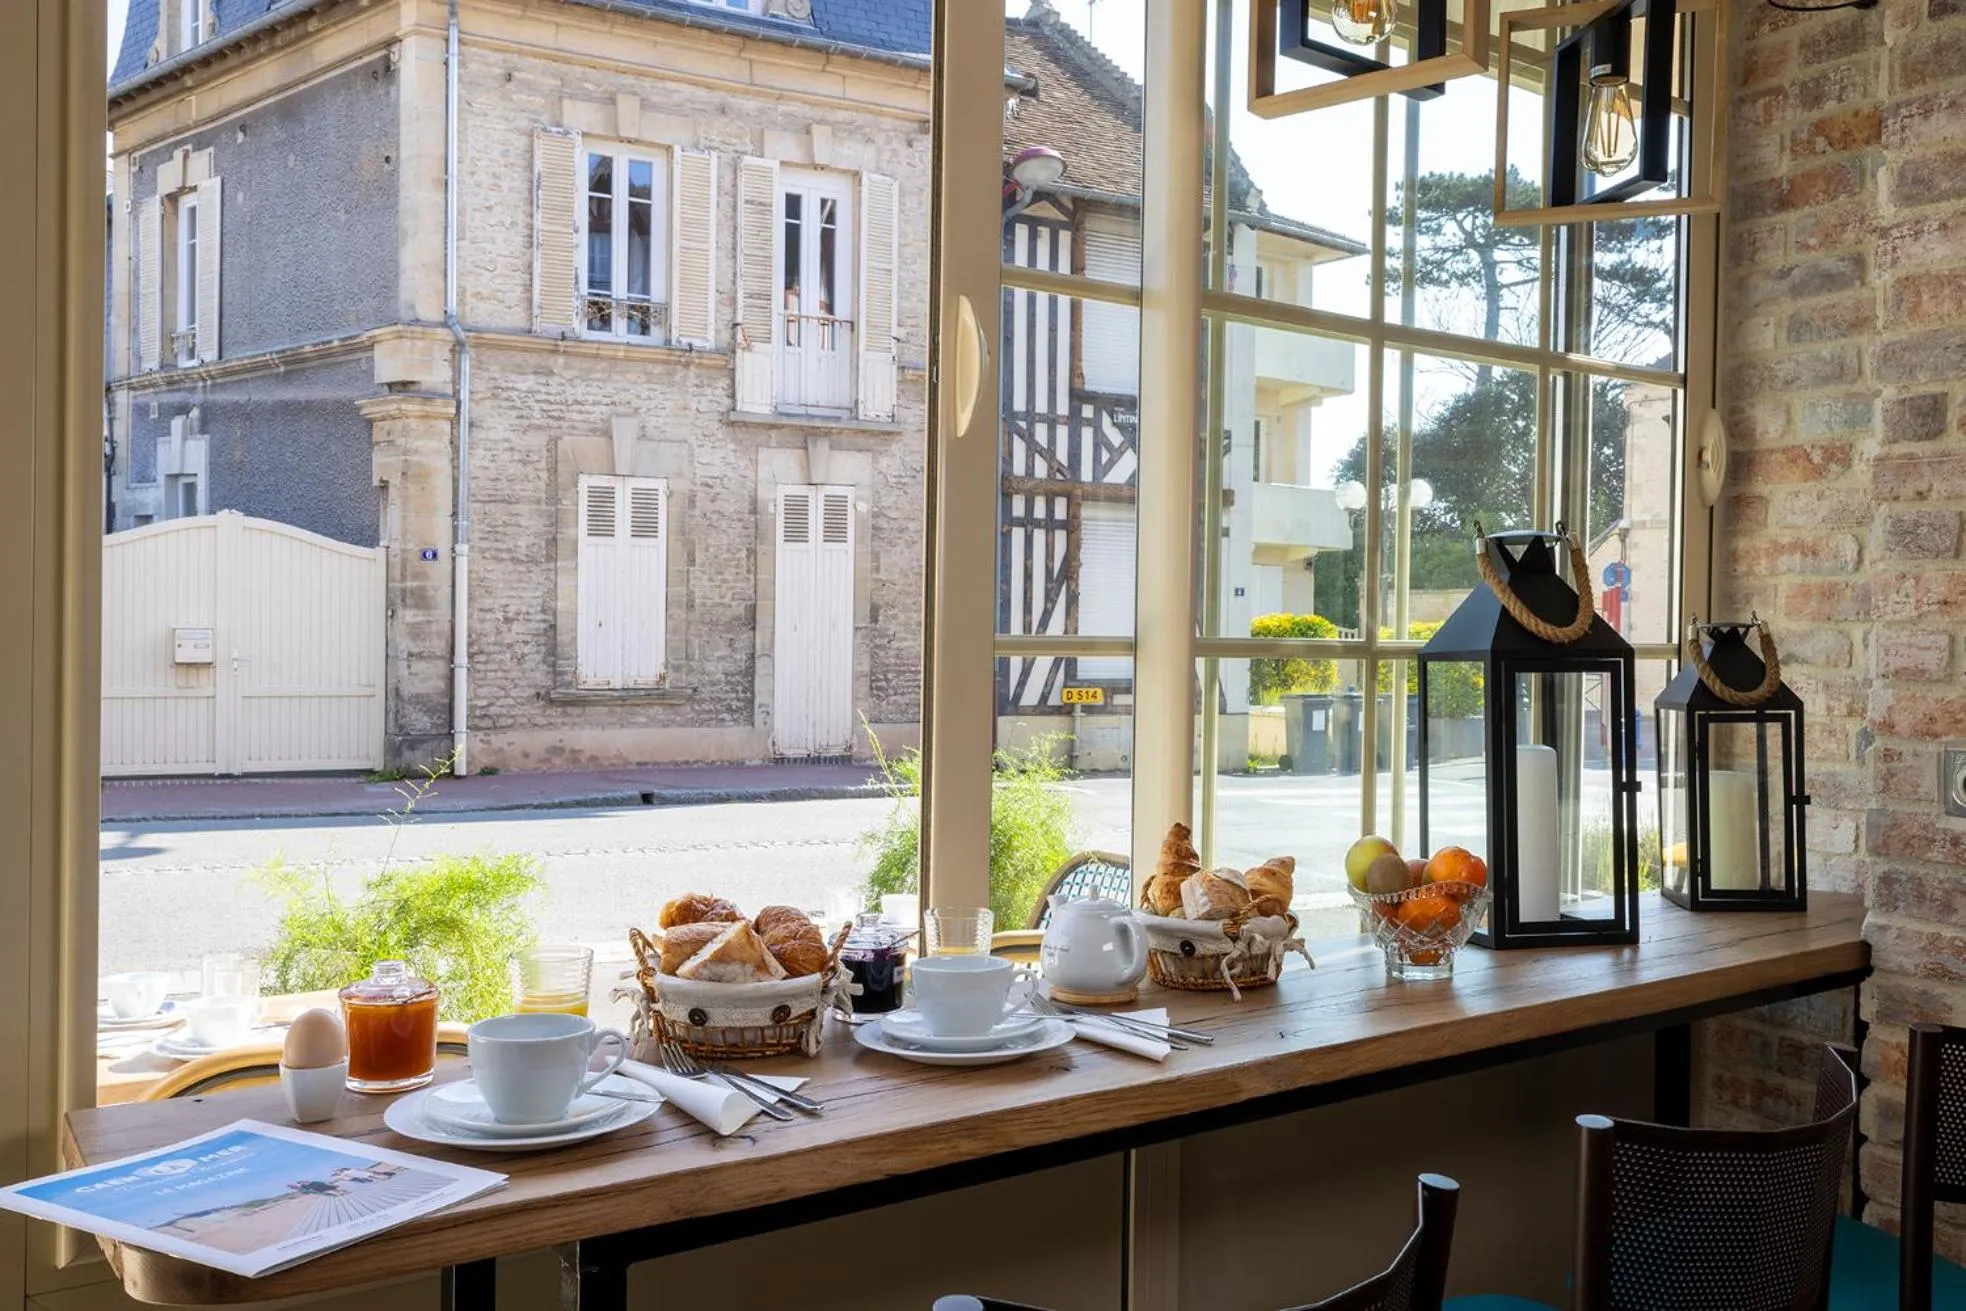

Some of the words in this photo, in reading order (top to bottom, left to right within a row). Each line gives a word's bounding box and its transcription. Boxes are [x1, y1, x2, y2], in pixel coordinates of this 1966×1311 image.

[1066, 690, 1073, 701] D
[1076, 690, 1098, 701] 514
[74, 1175, 141, 1193] CAEN
[198, 1145, 248, 1162] MER
